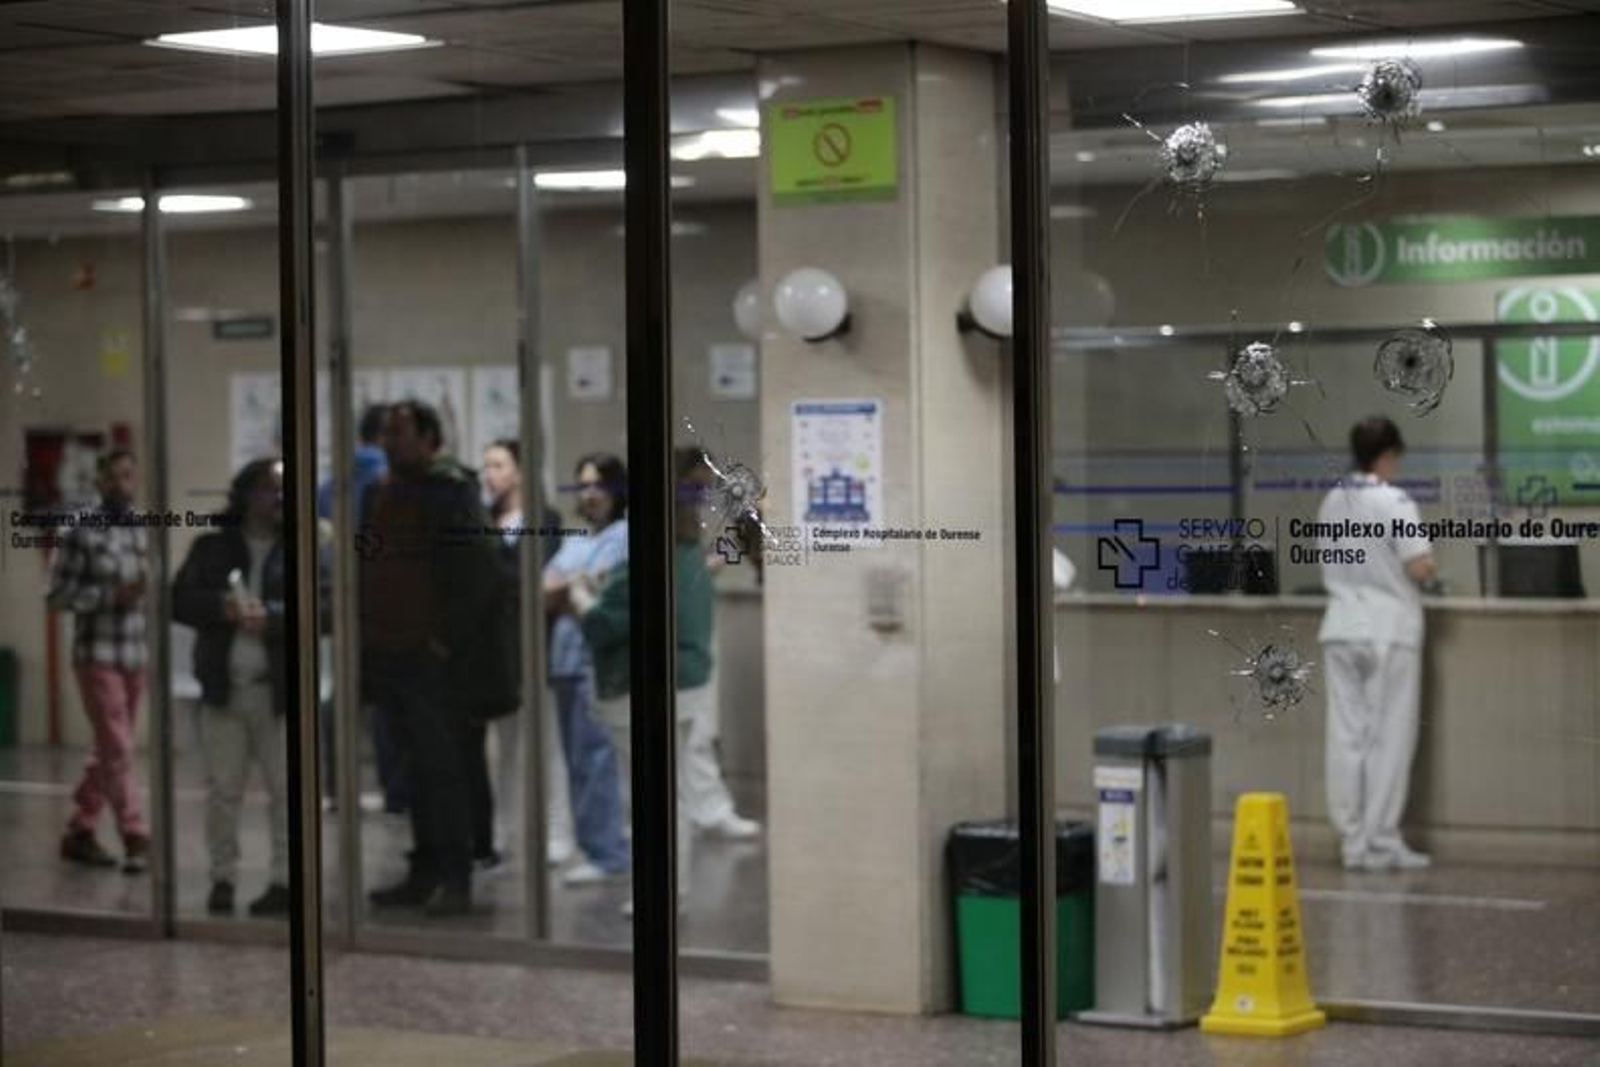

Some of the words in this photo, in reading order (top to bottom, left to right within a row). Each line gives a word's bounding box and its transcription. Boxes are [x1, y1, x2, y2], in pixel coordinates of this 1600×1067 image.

[1396, 229, 1586, 266] Información
[184, 510, 242, 529] Ouren
[1178, 517, 1265, 539] SERVIZO
[1289, 518, 1385, 543] Complexo
[1391, 518, 1513, 542] Hospitalario
[1519, 518, 1544, 539] de
[924, 528, 938, 541] de
[1289, 543, 1366, 565] Ourense
